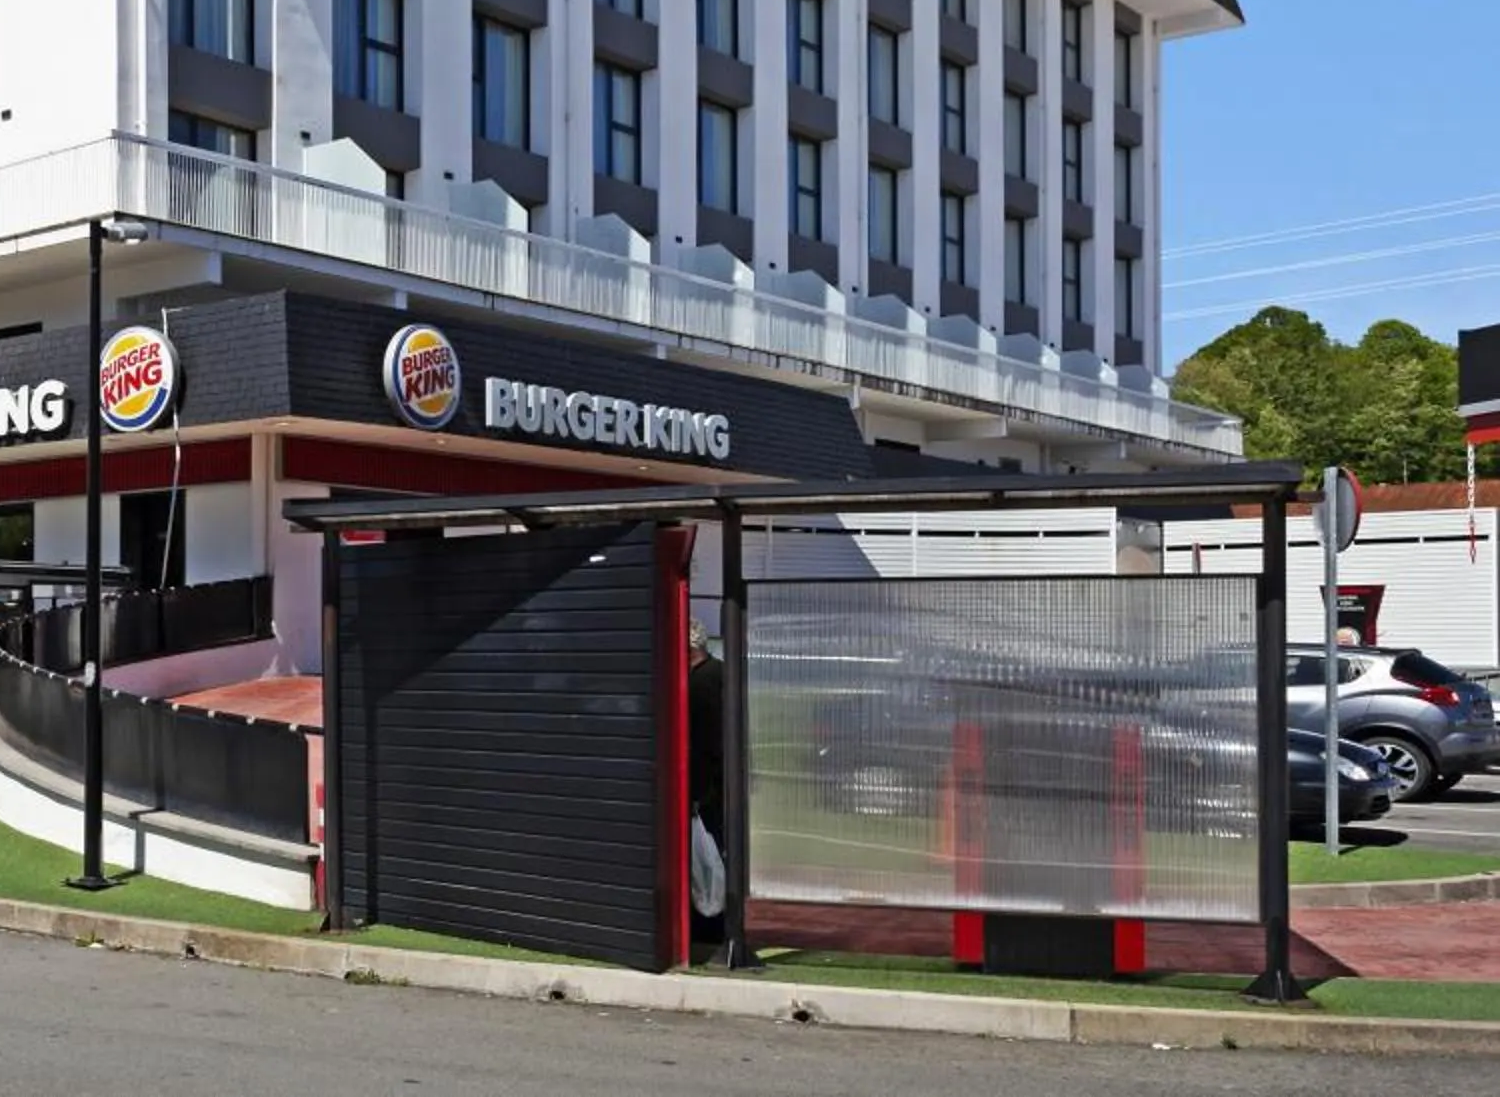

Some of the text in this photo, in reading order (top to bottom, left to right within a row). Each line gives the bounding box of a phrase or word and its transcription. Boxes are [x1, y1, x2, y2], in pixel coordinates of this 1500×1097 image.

[101, 342, 161, 386] BURGER
[402, 346, 452, 376] BURGER
[101, 360, 162, 413] KING
[404, 364, 455, 403] KING
[485, 376, 730, 461] BURGER KING
